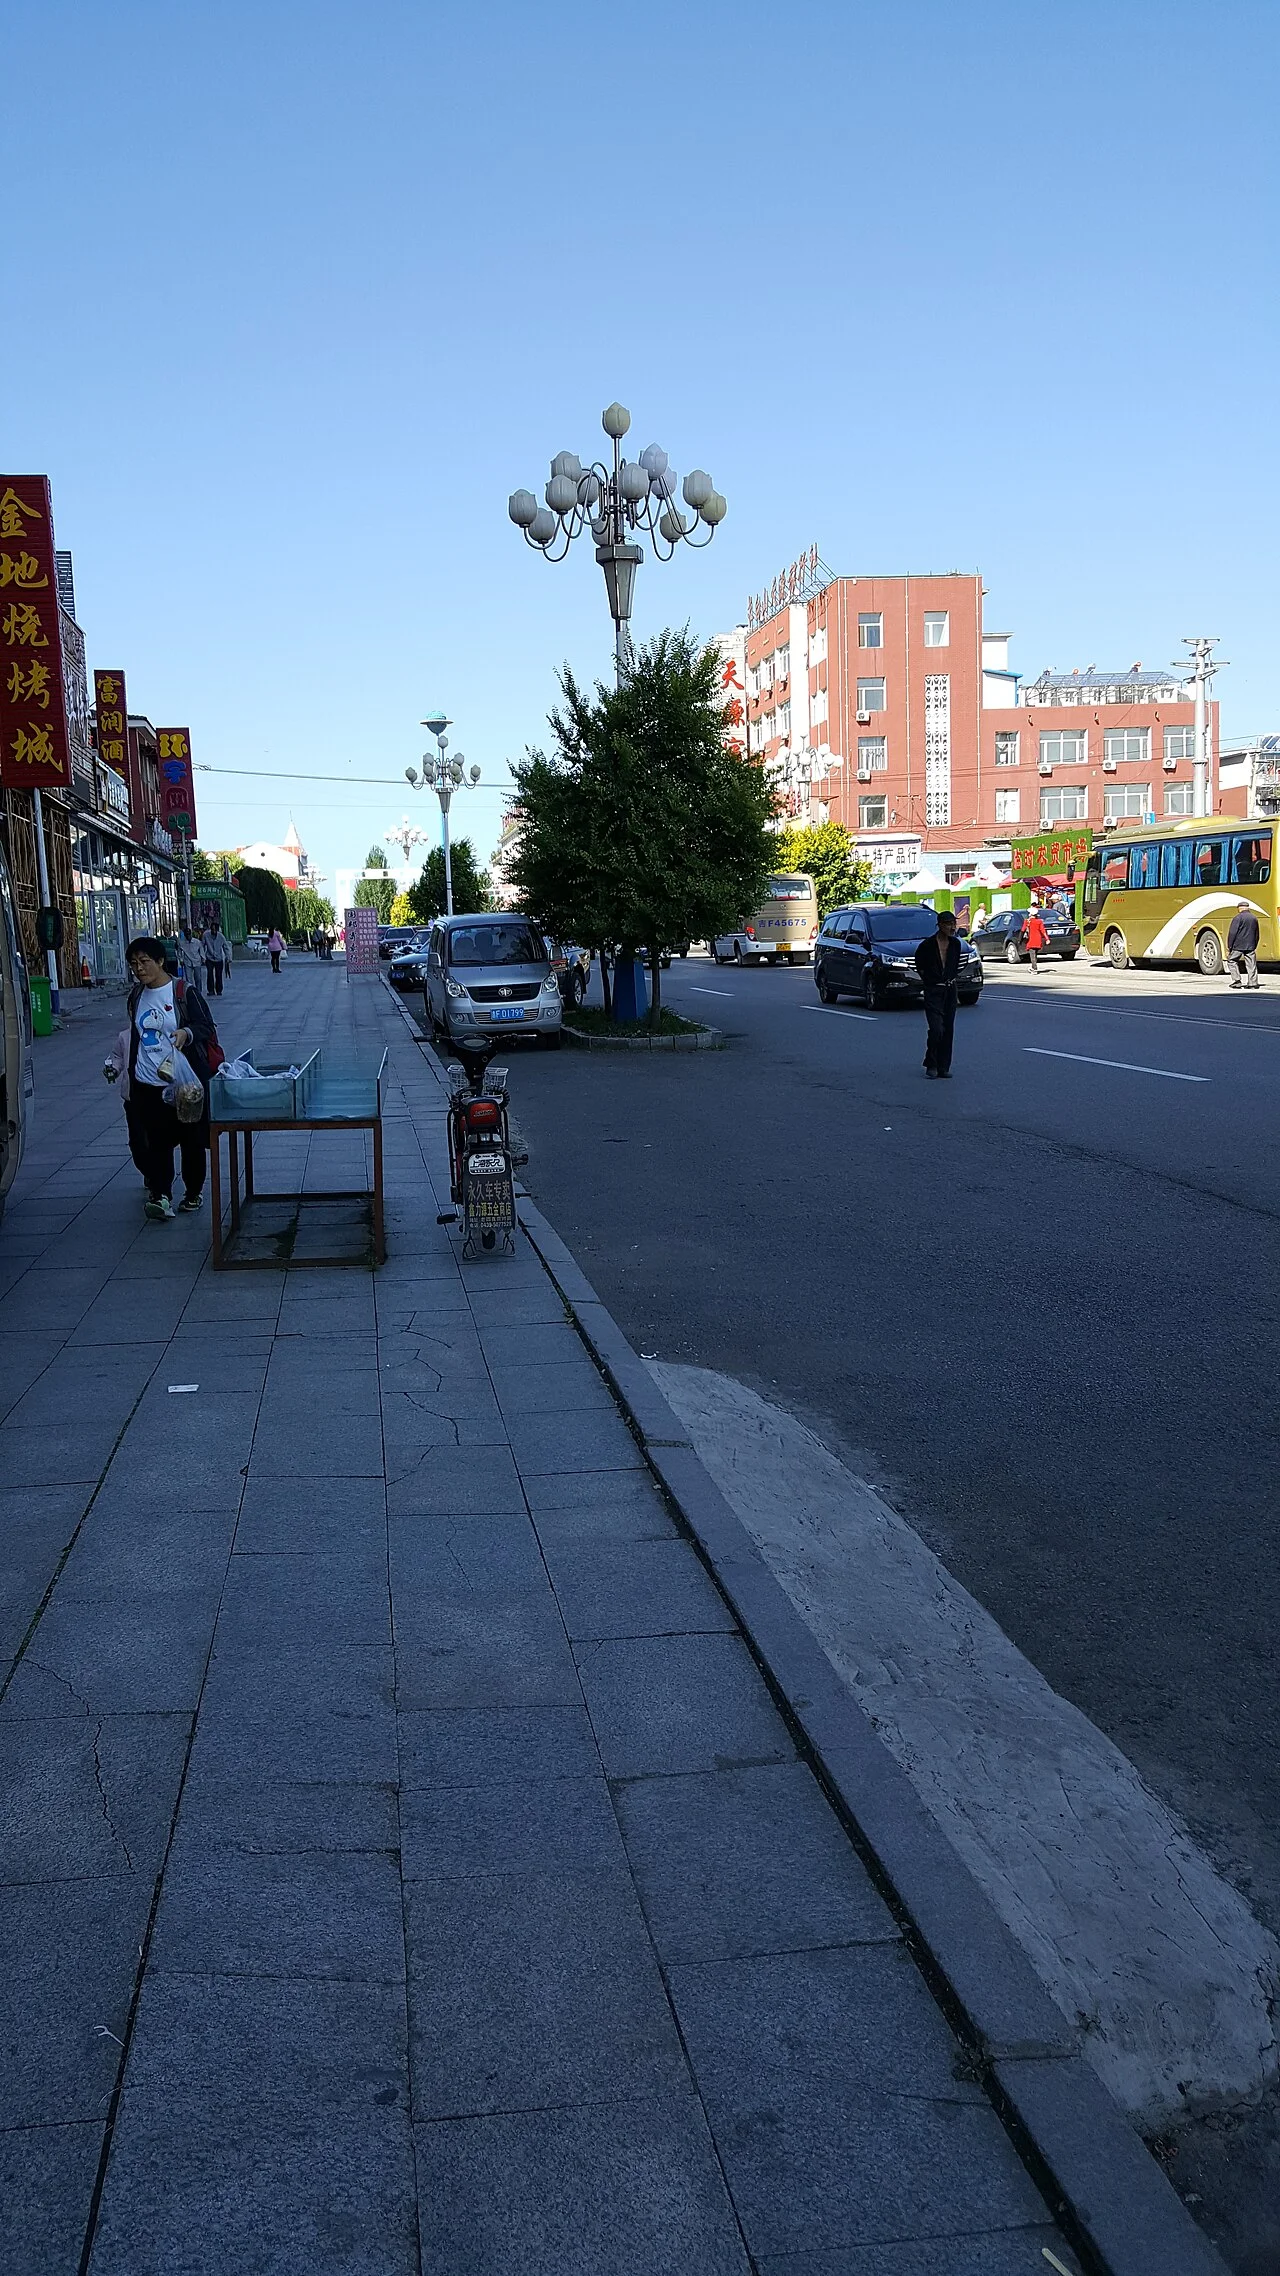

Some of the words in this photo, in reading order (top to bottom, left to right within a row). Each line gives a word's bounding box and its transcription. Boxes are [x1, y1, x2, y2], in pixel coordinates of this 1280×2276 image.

[0, 487, 63, 774] 金地烧烤城
[97, 675, 125, 776] 富润酒
[1013, 838, 1087, 870] 临时农贸市场
[758, 918, 807, 928] 吉F45675
[468, 1180, 511, 1201] 永久车专卖
